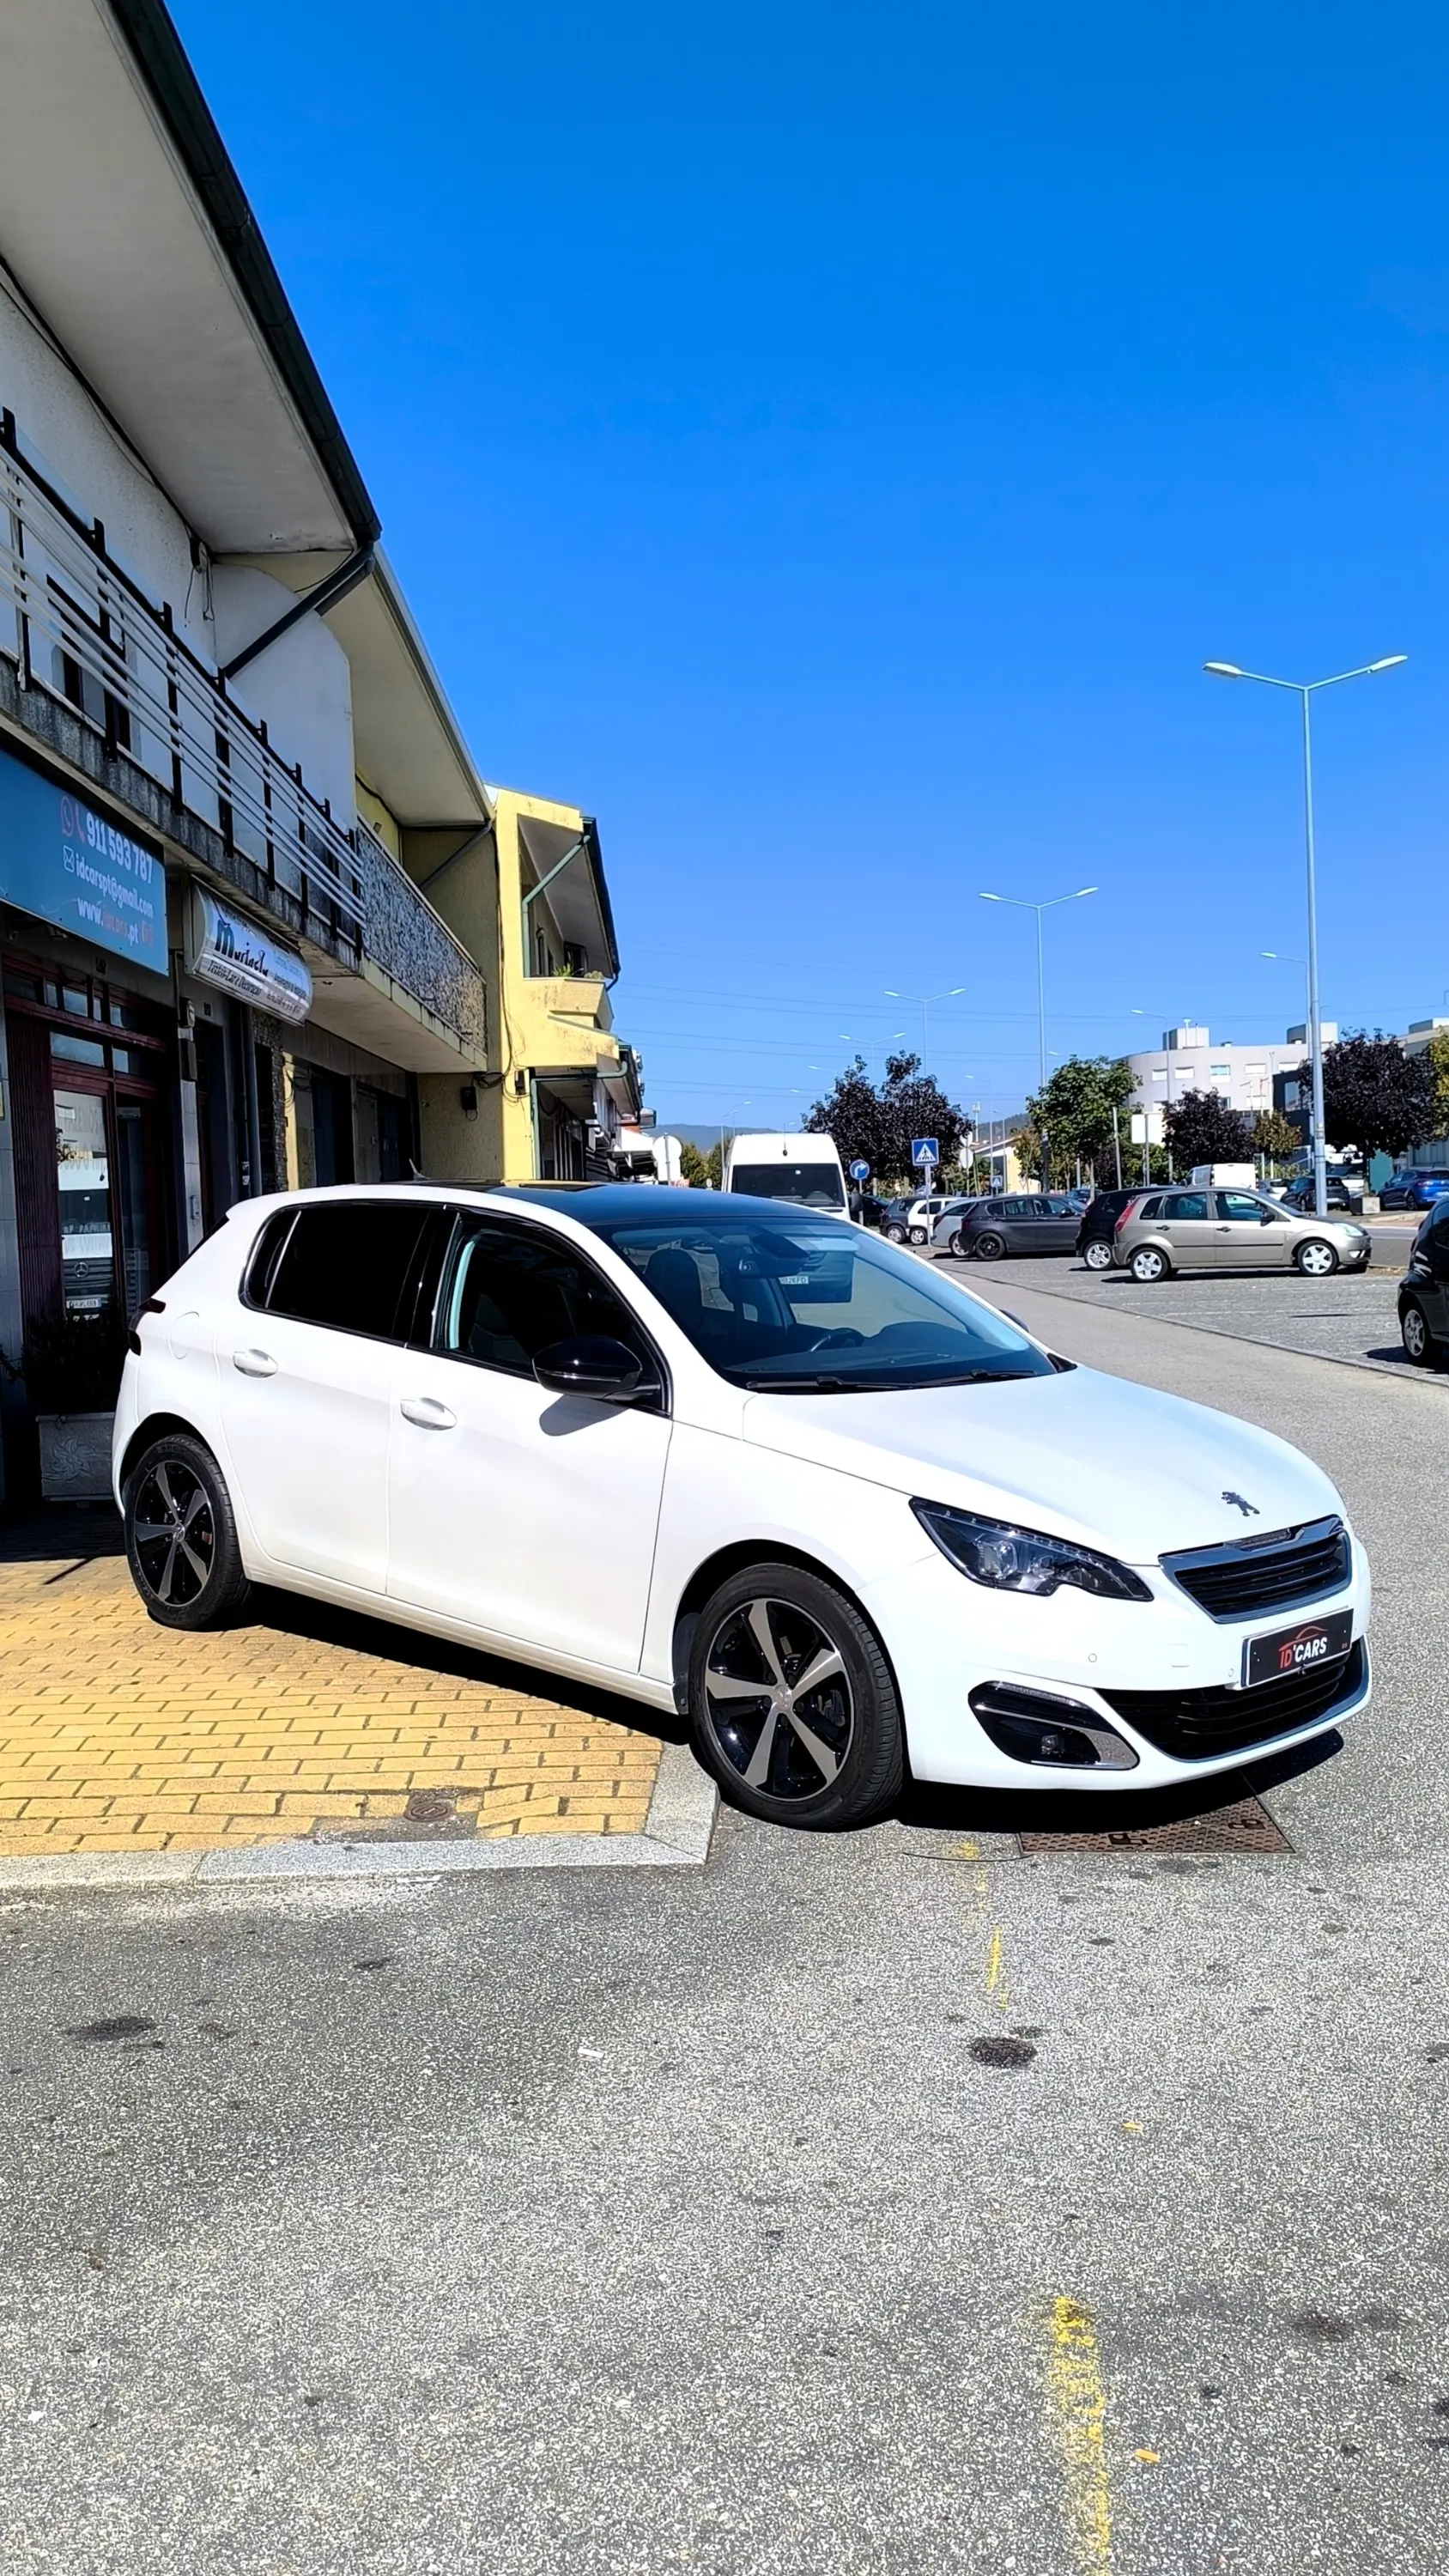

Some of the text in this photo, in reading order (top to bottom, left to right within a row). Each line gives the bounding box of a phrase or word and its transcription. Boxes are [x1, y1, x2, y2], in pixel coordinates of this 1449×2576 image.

[87, 812, 153, 884] 911 593 787
[76, 853, 154, 919] idcarspt@gmail.com
